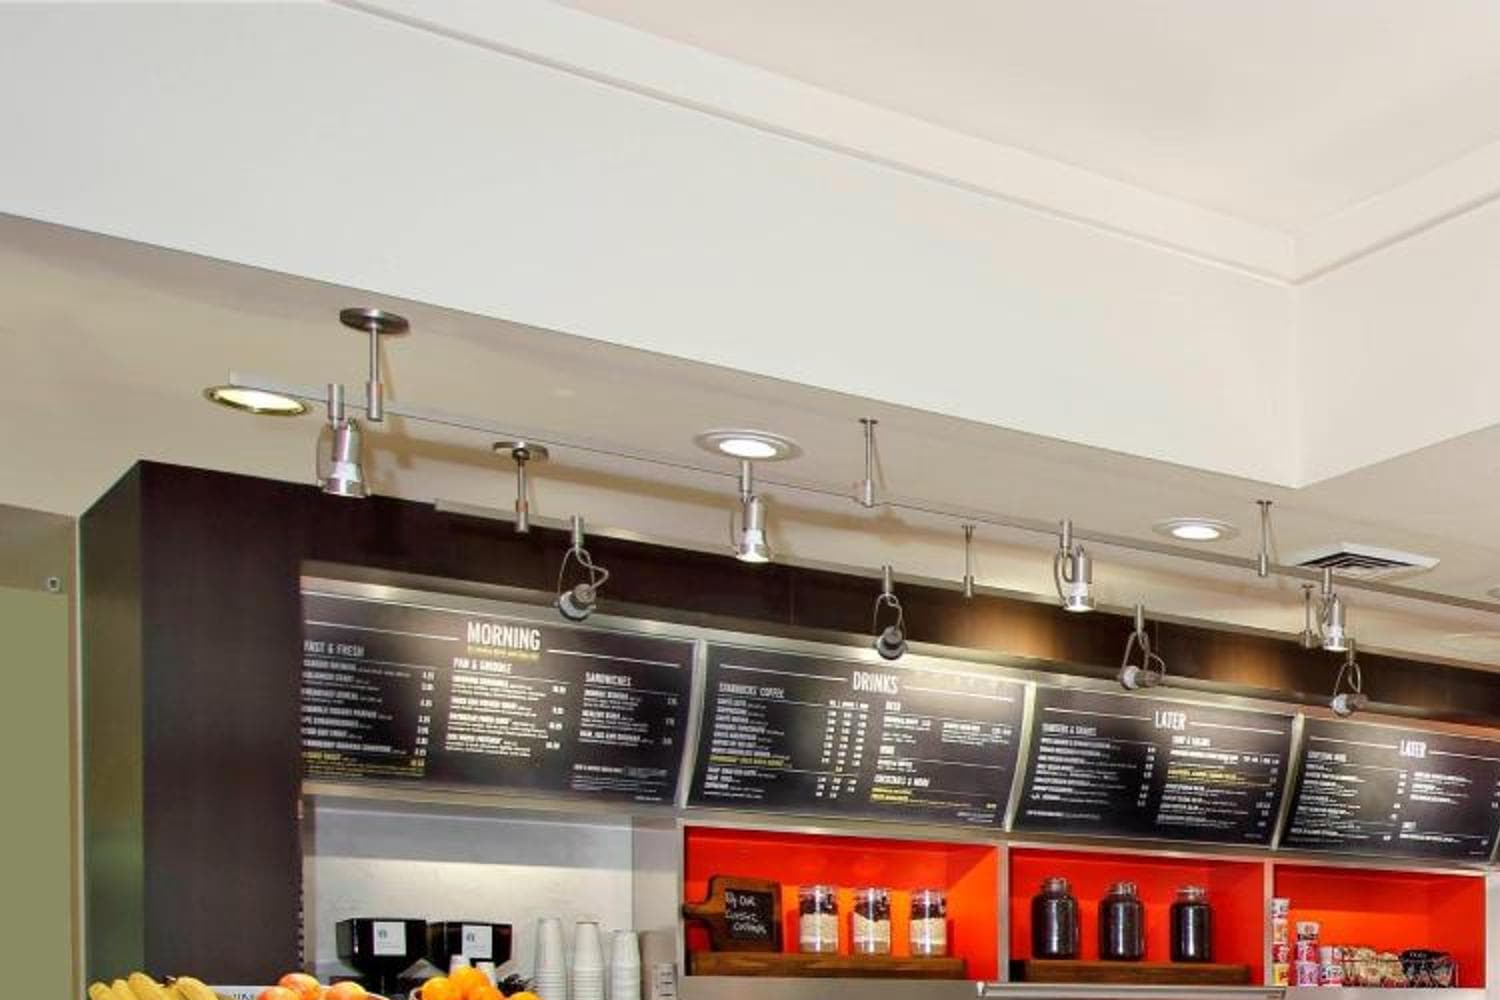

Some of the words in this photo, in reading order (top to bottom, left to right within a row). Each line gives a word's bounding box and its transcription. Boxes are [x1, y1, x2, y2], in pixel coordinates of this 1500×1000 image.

[467, 621, 541, 651] MORNING
[852, 671, 899, 695] DRINKS
[1155, 711, 1186, 731] LATER
